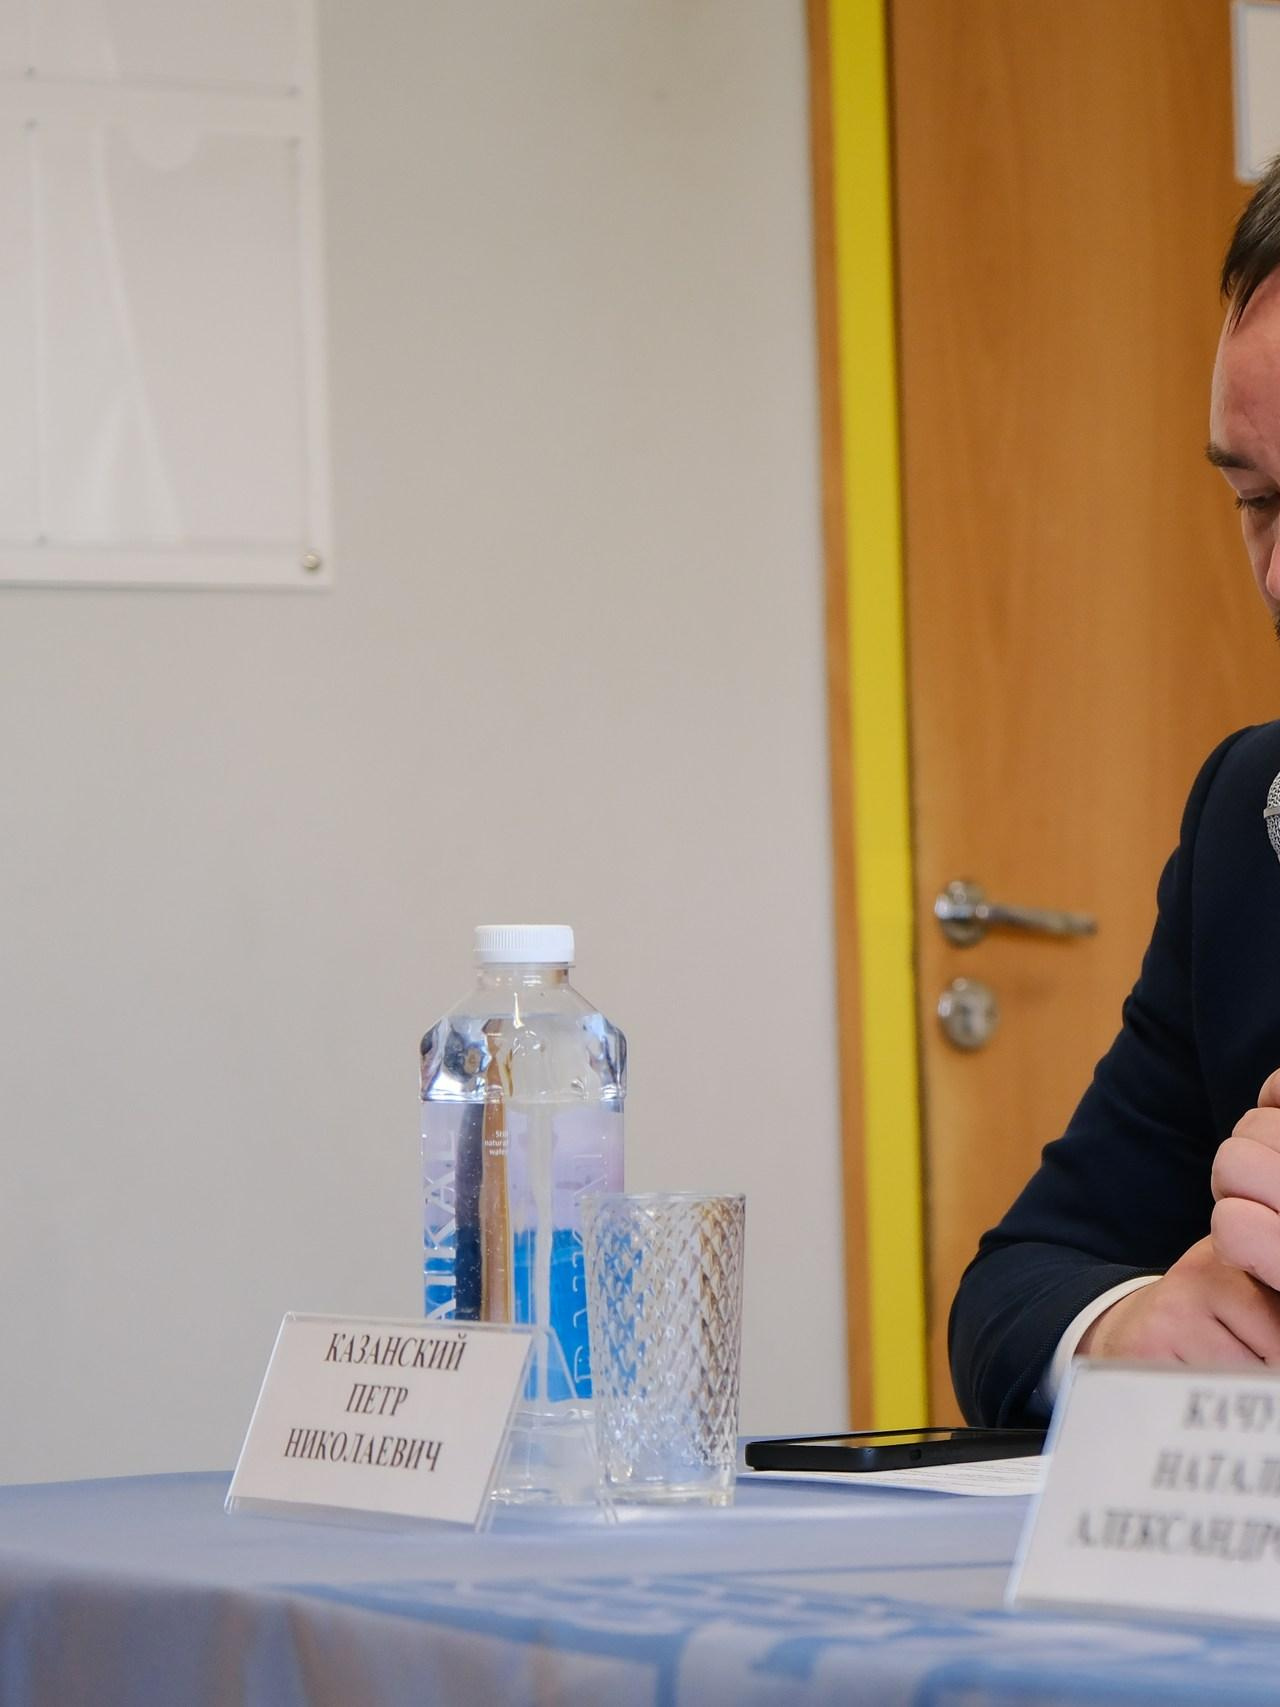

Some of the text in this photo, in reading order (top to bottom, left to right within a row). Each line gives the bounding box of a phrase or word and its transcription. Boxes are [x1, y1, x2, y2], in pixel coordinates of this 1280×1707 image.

[323, 1332, 468, 1372] КАЗАНСКИЙ
[344, 1383, 409, 1417] ПЕТР
[283, 1428, 444, 1473] НИКОЛАЕВИЧ
